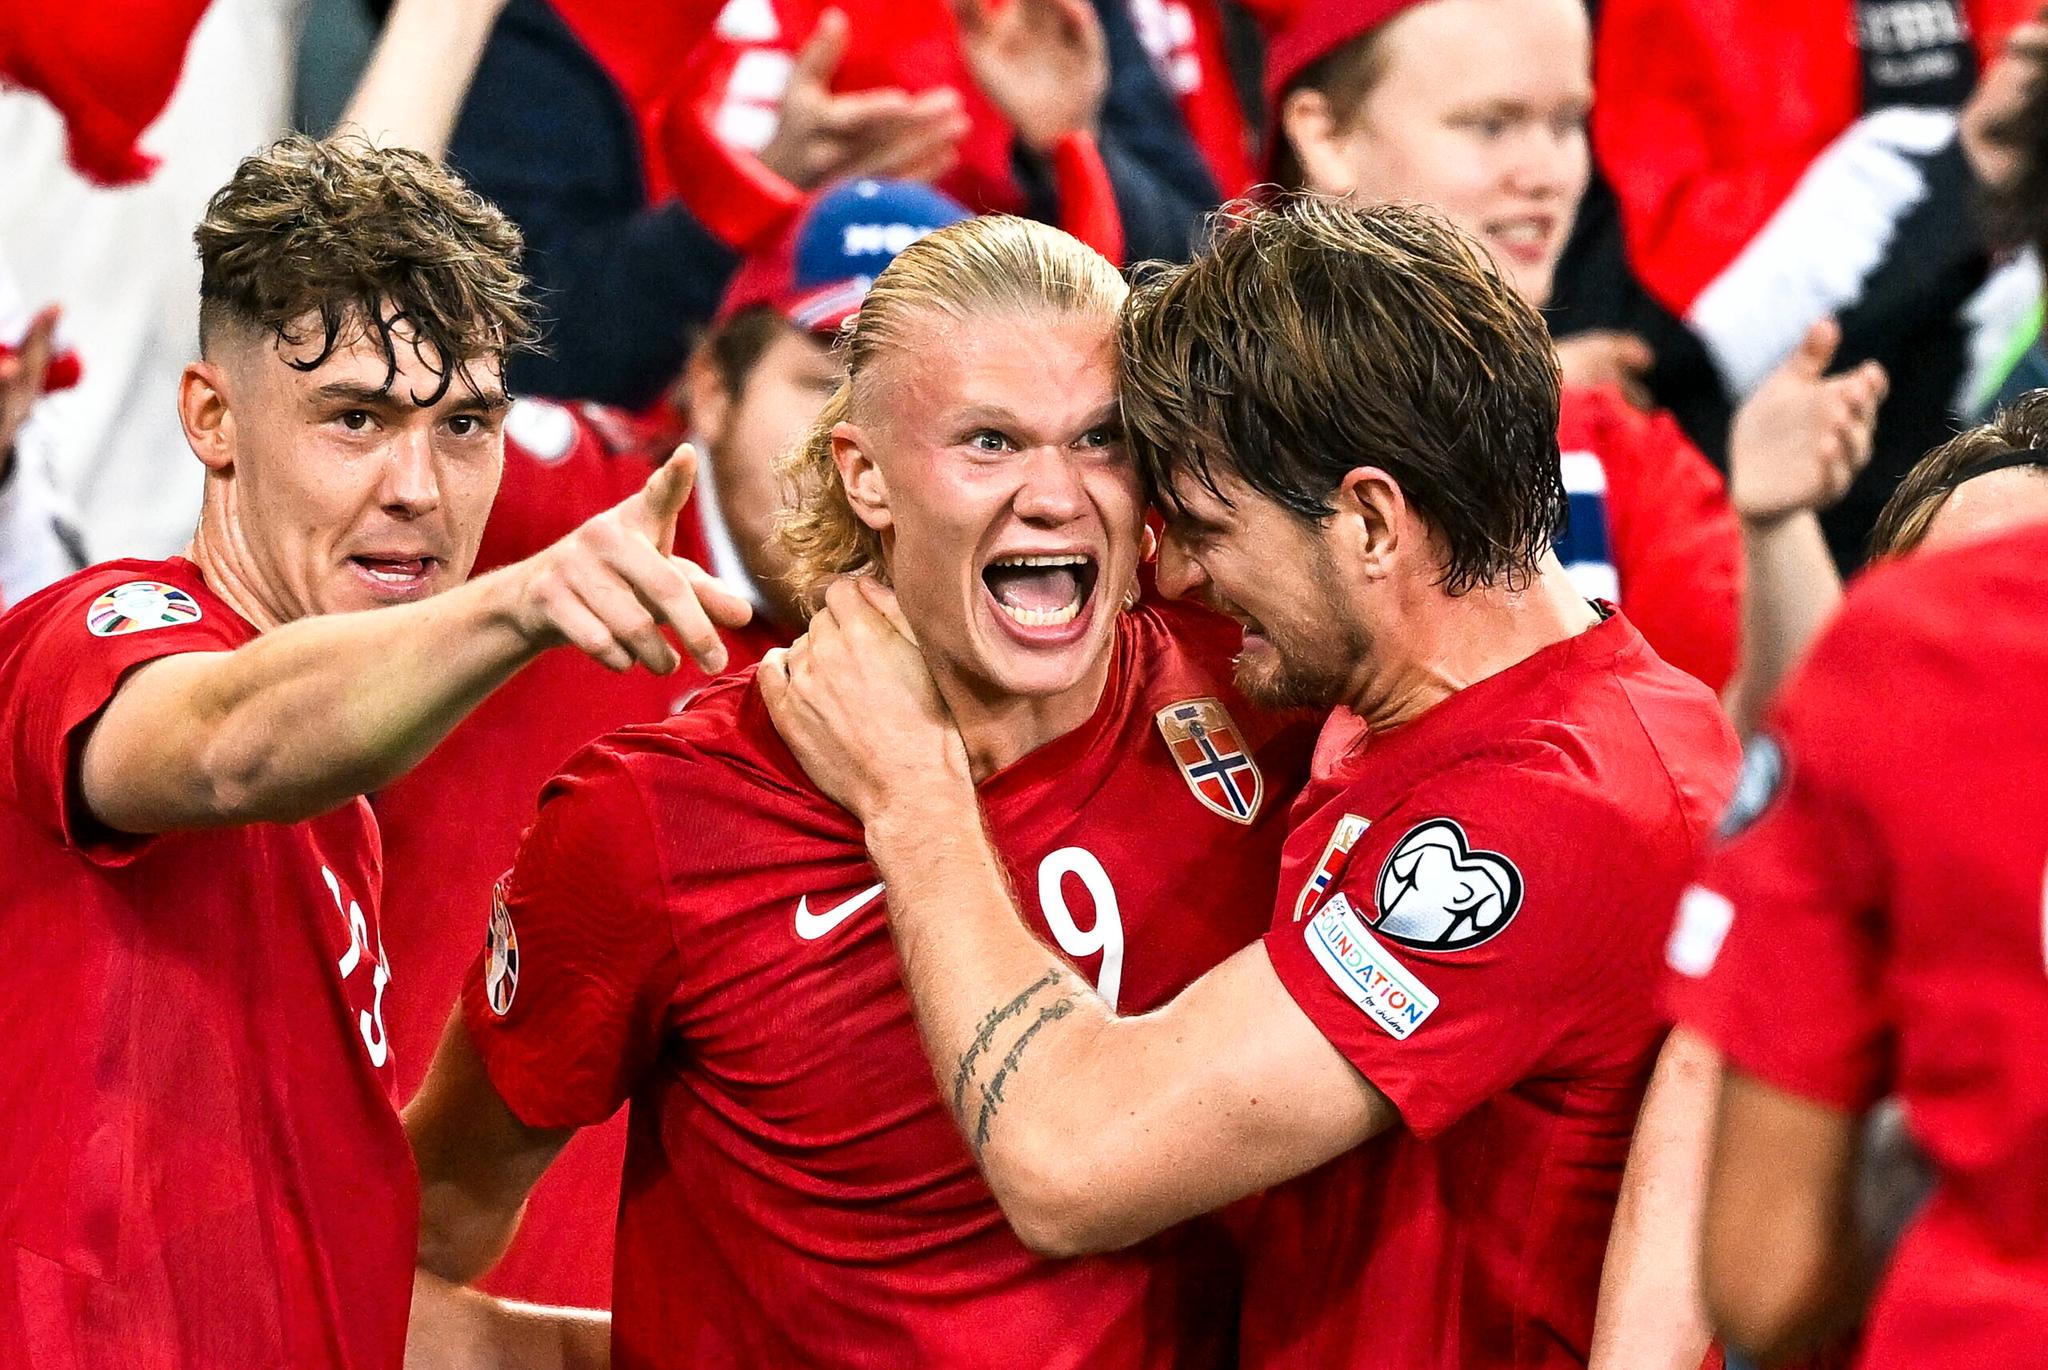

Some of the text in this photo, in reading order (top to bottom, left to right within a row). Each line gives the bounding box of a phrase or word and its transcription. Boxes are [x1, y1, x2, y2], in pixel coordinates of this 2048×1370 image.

[1038, 846, 1124, 1013] 9
[1360, 996, 1405, 1035] for children
